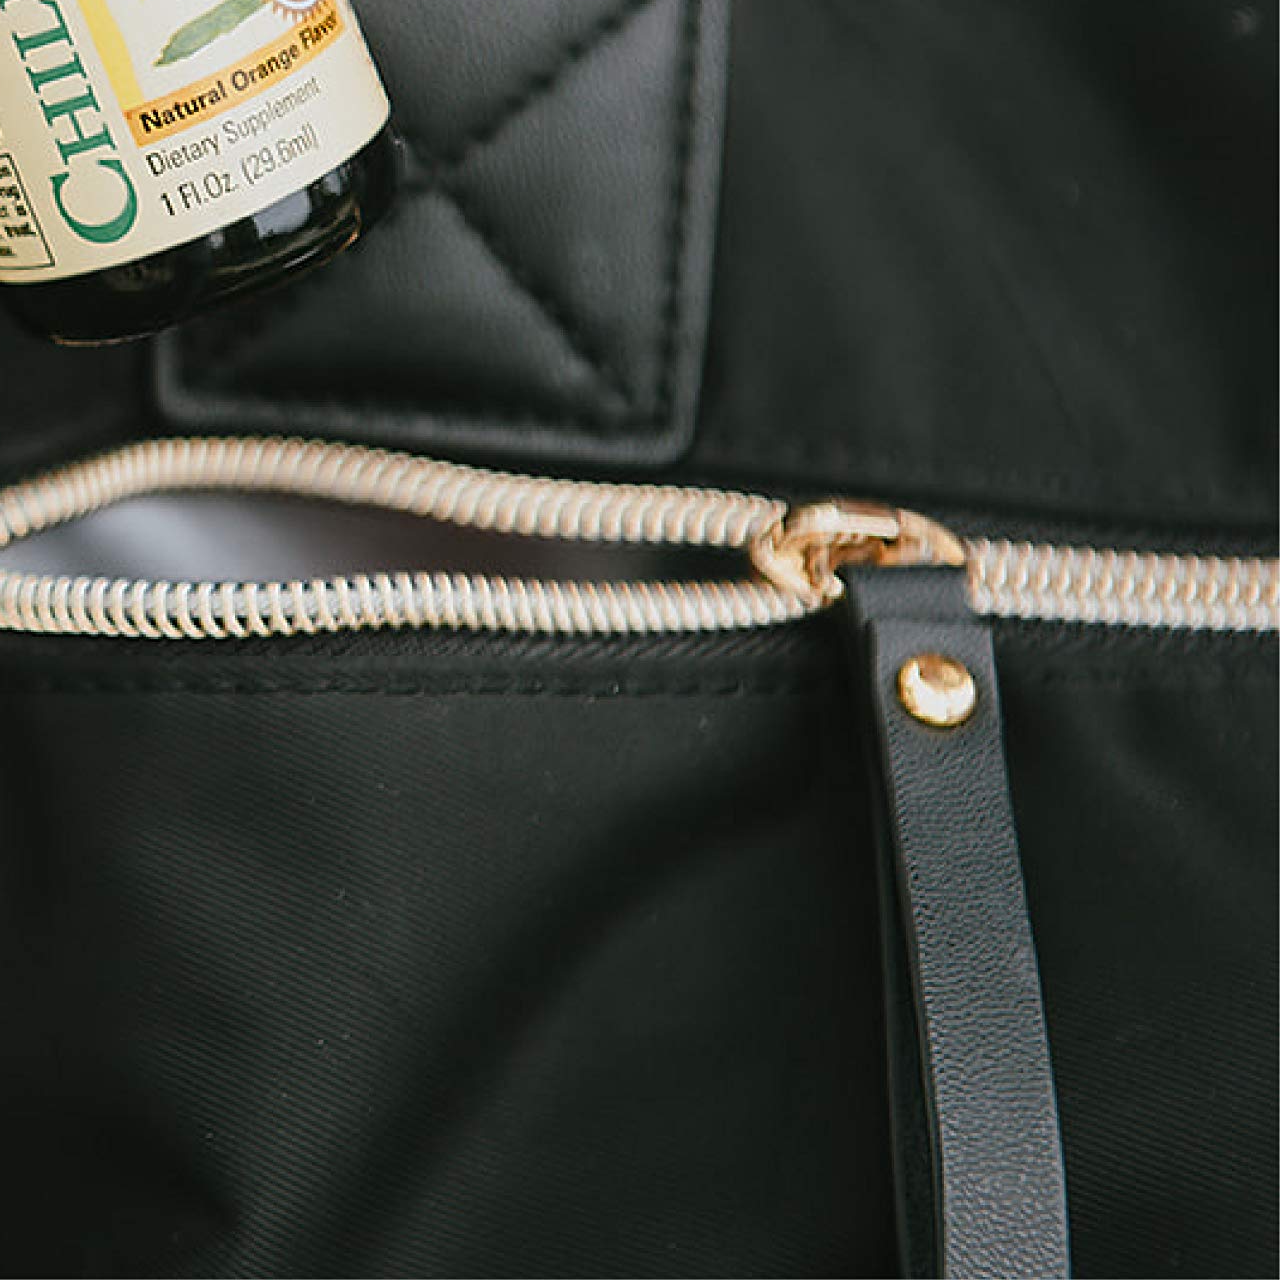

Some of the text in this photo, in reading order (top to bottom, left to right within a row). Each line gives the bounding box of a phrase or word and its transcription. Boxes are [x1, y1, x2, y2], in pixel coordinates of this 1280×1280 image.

[139, 10, 337, 134] Natural Orange Flavor
[146, 76, 321, 177] Dietary Supplement
[161, 192, 176, 216] 1
[241, 121, 320, 186] (29.6ml)
